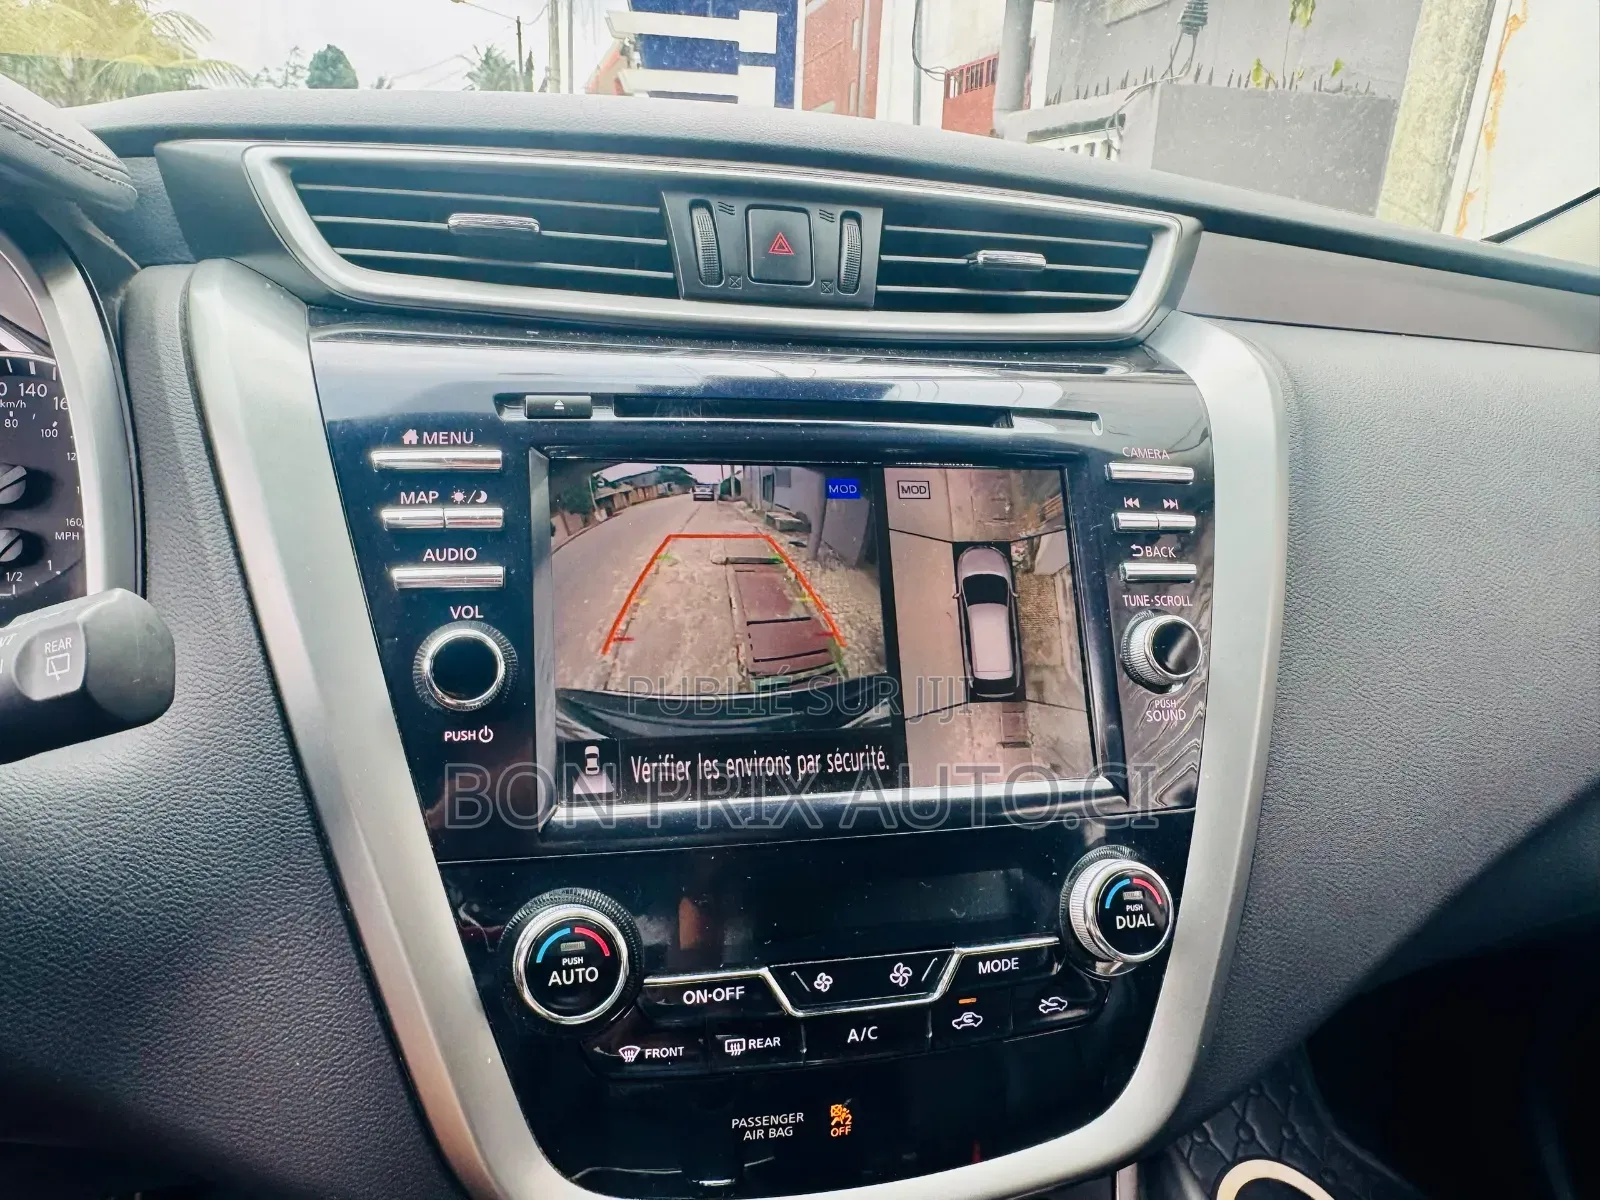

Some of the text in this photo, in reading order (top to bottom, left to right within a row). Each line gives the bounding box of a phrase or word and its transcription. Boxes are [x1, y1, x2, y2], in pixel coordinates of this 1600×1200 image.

[18, 383, 48, 397] 140
[0, 399, 27, 408] km/h
[4, 419, 19, 428] 80
[40, 428, 58, 438] 100
[422, 431, 475, 445] MENU
[1122, 446, 1170, 460] CAMERA
[828, 484, 857, 495] MOD
[900, 485, 927, 495] MOD
[400, 490, 440, 505] MAP
[65, 517, 83, 527] 160
[54, 531, 80, 541] MPH
[422, 547, 478, 562] AUDIO
[1145, 546, 1177, 558] BACK
[5, 571, 24, 582] 1/2
[449, 605, 484, 619] VOL
[44, 637, 73, 654] REAR
[1153, 700, 1178, 710] PUSH
[1145, 709, 1187, 723] SOUND
[444, 730, 476, 742] PUSH
[630, 744, 891, 784] Vérifier les environs par sécurité.
[1125, 903, 1144, 912] PUSH
[1116, 914, 1155, 930] DUAL
[561, 956, 584, 966] PUSH
[977, 957, 1020, 974] MODE
[548, 967, 599, 987] AUTO
[847, 1026, 878, 1043] A/C
[748, 1036, 781, 1050] REAR
[645, 1046, 685, 1059] FRONT
[731, 1112, 804, 1129] PASSENGER
[743, 1126, 793, 1141] AIR BAG
[830, 1125, 852, 1137] OFF
